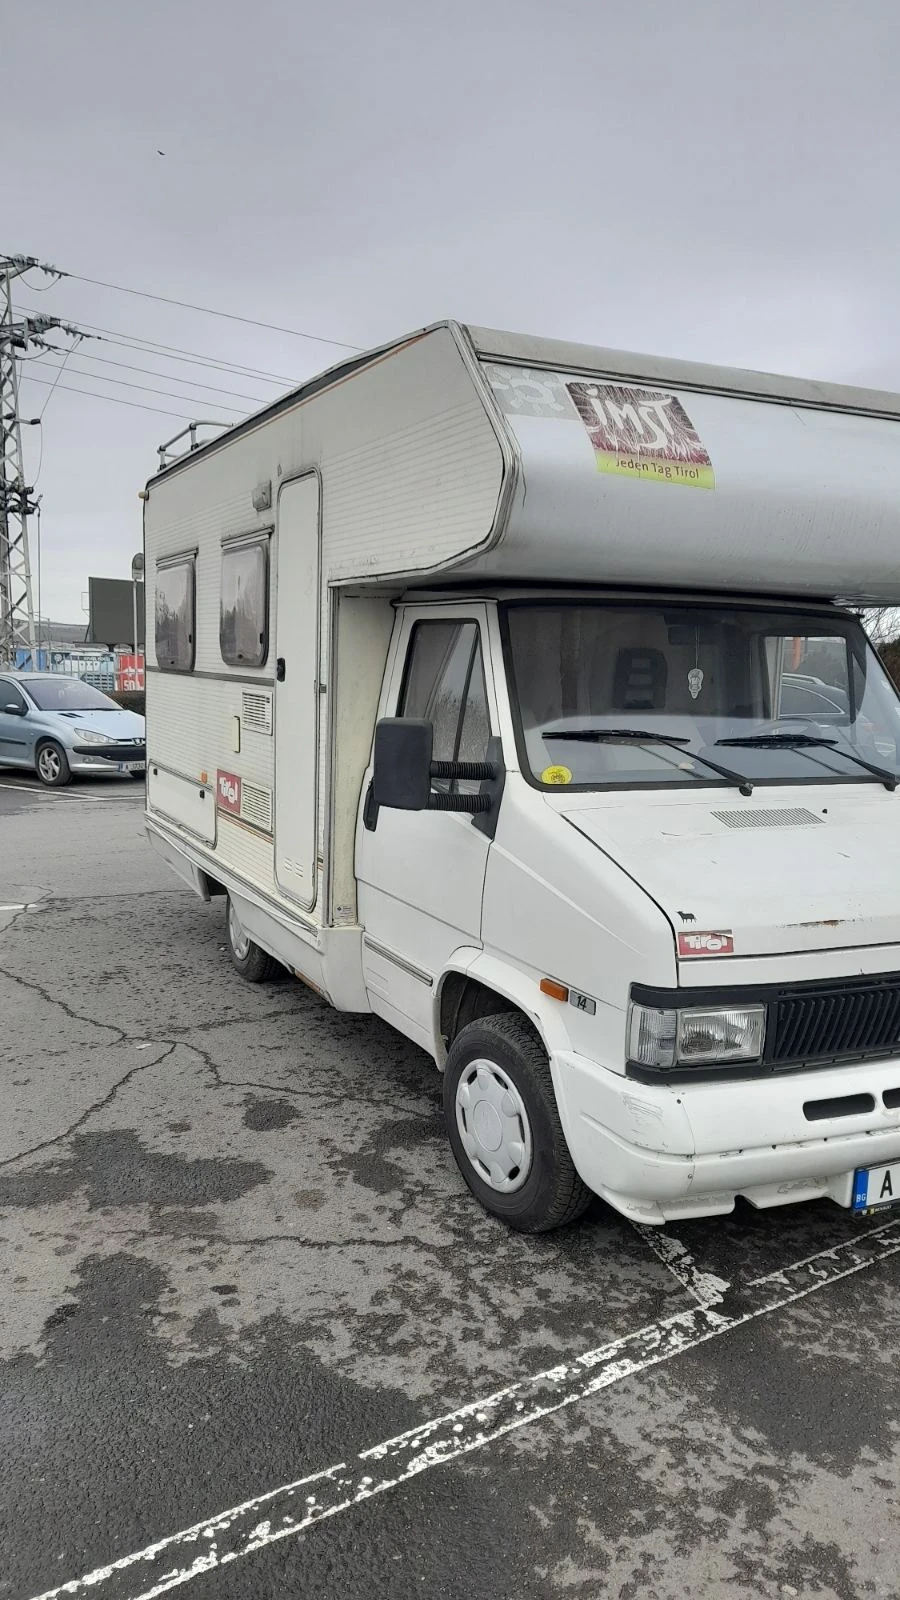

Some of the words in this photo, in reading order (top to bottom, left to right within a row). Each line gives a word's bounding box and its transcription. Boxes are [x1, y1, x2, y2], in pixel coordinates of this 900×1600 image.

[616, 458, 649, 471] Jeden
[651, 462, 672, 478] Tag
[673, 465, 699, 479] Tirol
[576, 995, 587, 1010] 14
[880, 1169, 893, 1198] A
[856, 1193, 866, 1203] BG
